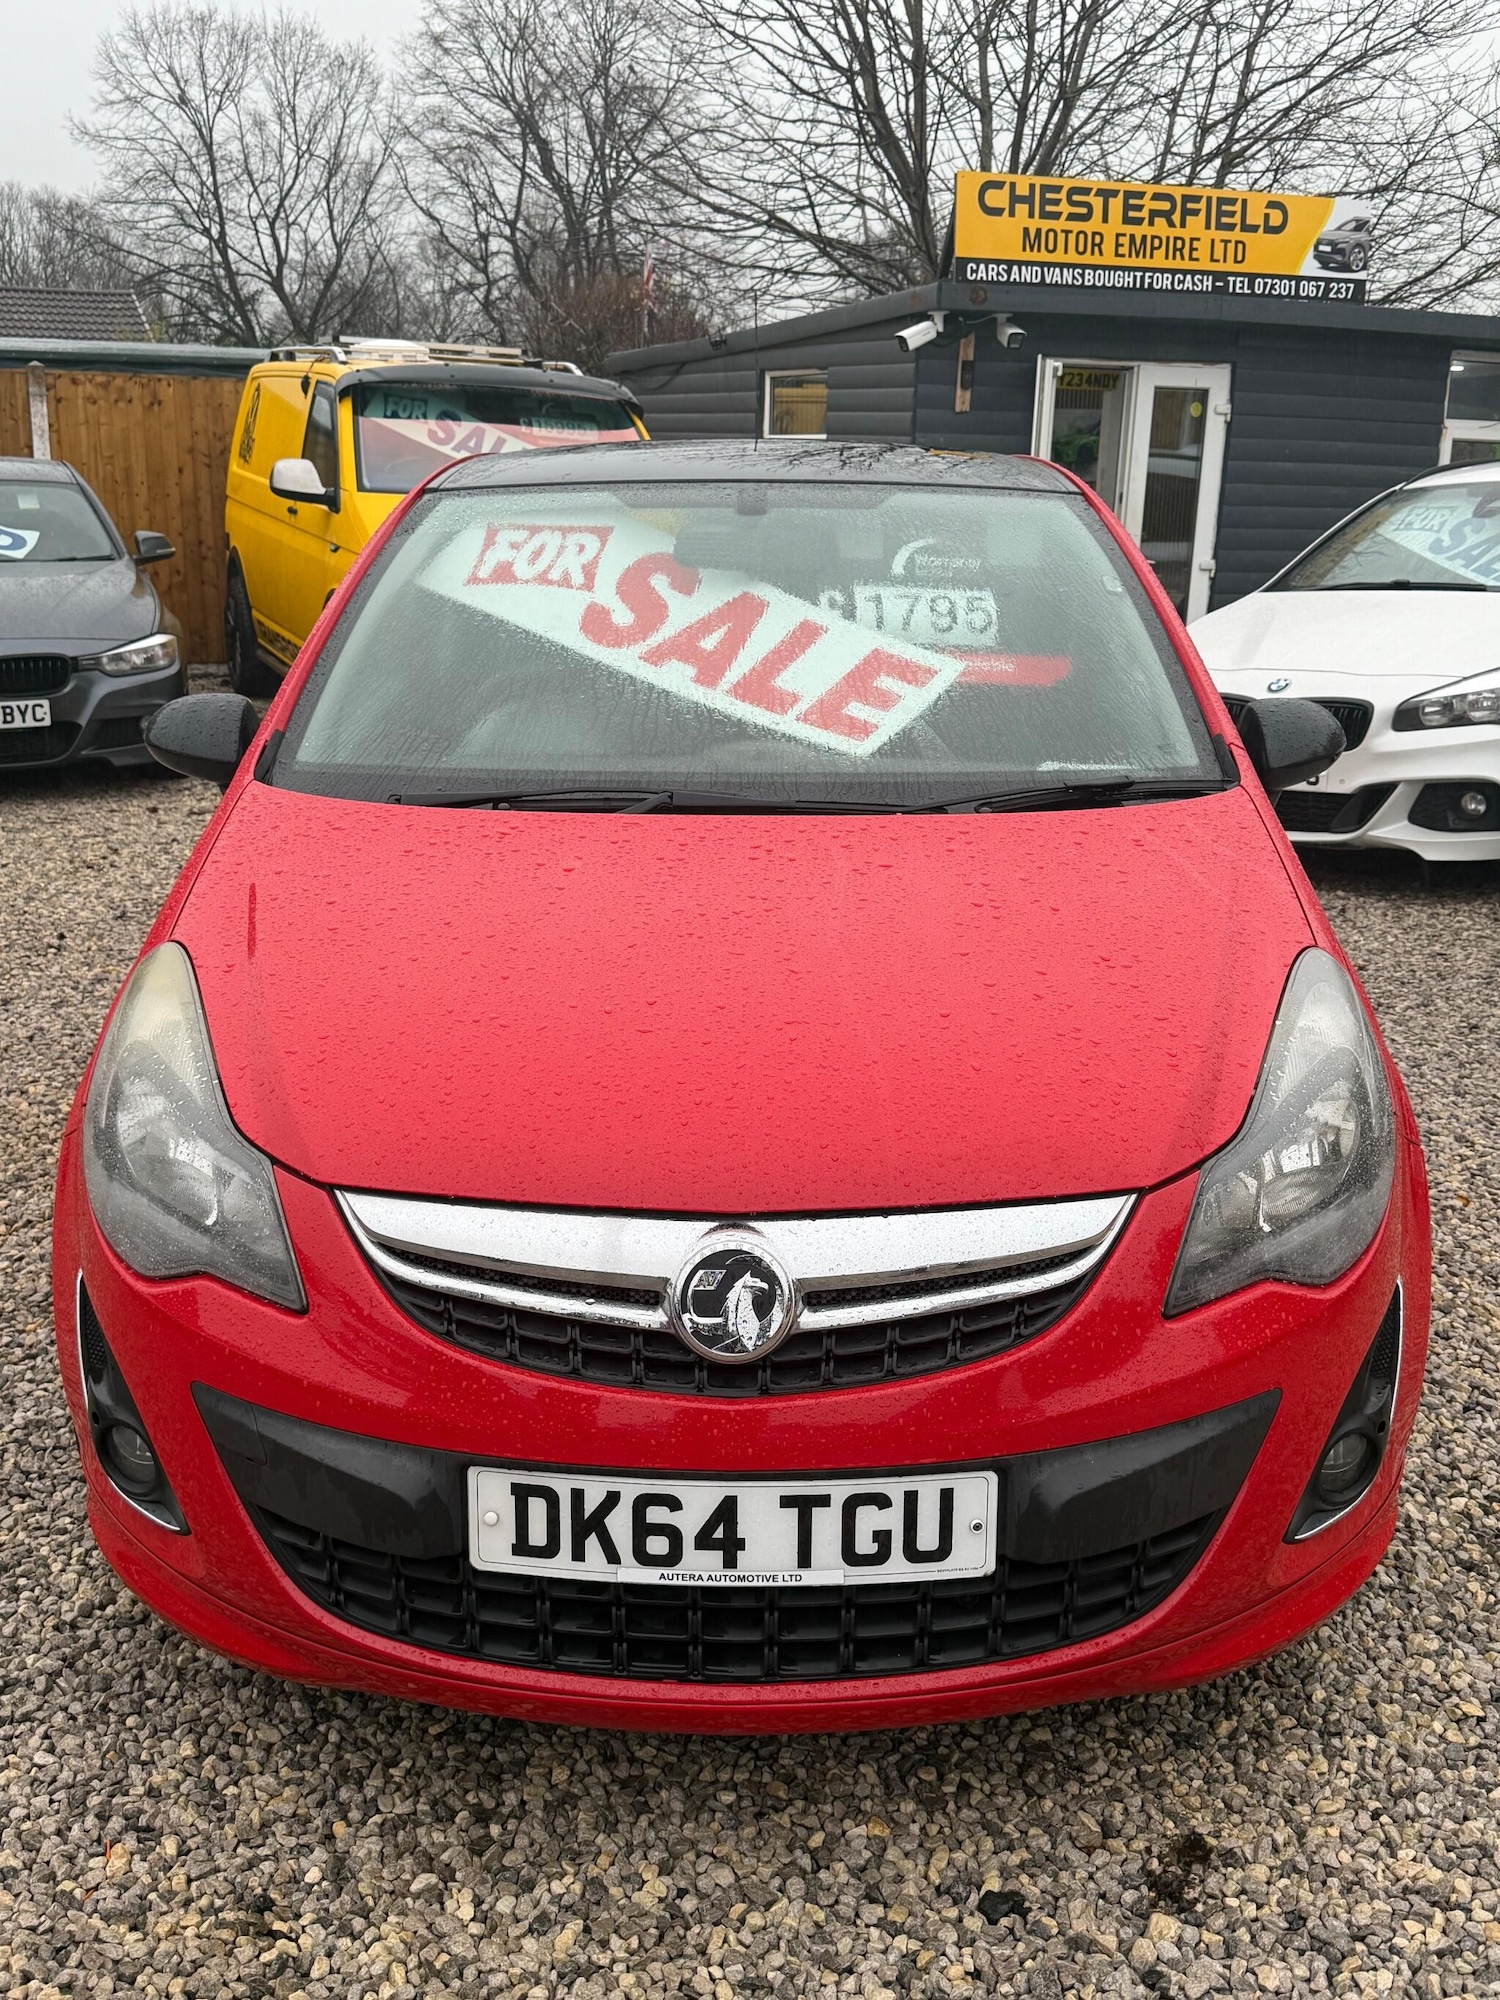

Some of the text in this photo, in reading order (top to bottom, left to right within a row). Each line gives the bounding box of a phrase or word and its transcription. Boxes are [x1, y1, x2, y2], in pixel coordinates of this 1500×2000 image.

[977, 179, 1289, 235] CHESTERFIELD
[1021, 226, 1247, 265] MOTOR EMPIRE LTD
[966, 262, 1008, 283] CARS
[1010, 264, 1042, 284] AND
[1043, 266, 1083, 286] VANS
[1084, 268, 1144, 289] BOUGHT
[1144, 272, 1172, 291] FOR
[1174, 273, 1213, 292] CASH
[1227, 276, 1252, 294] TEL
[1254, 278, 1296, 296] 07301
[1299, 281, 1326, 298] 067
[1328, 282, 1355, 300] 237
[384, 395, 428, 421] FOR
[478, 525, 604, 589] FOR
[578, 551, 943, 743] SALE
[0, 703, 47, 725] BYC
[509, 1480, 955, 1570] DK64 TGU
[658, 1572, 803, 1584] AUTERA AUTOMOTIVE LTD
